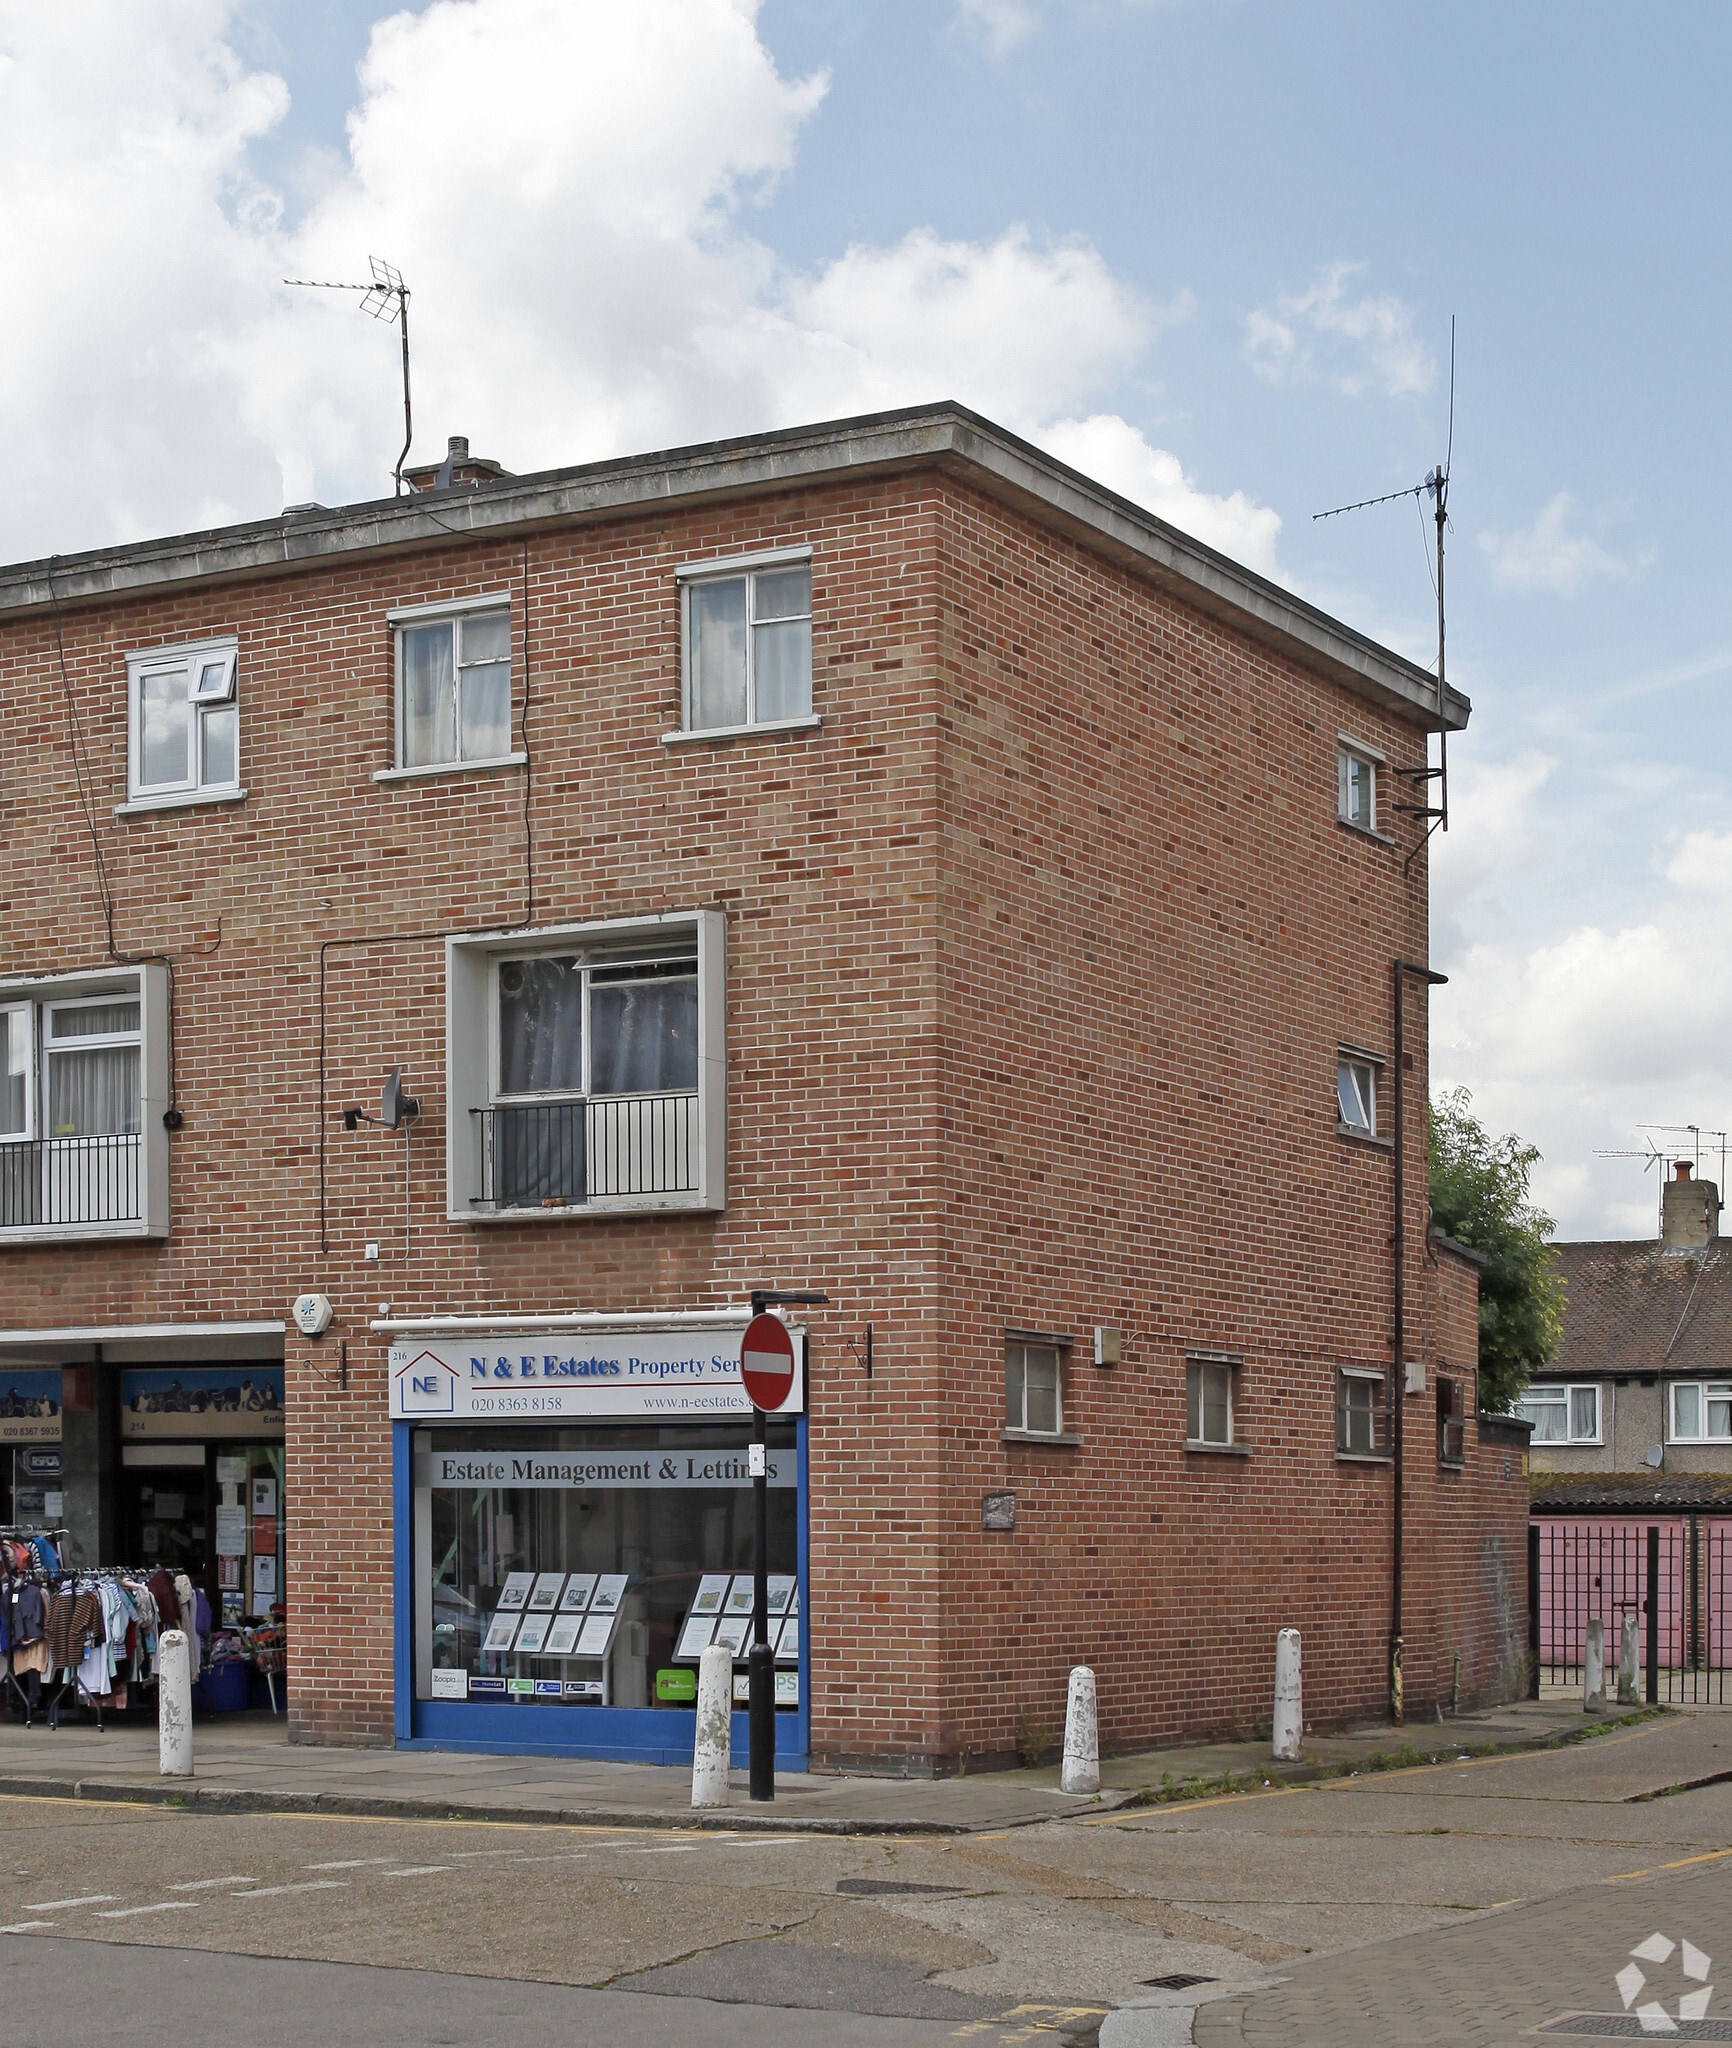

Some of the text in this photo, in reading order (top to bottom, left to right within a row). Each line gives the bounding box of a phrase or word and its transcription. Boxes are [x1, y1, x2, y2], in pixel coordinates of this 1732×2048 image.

[393, 1352, 407, 1361] 216
[469, 1355, 741, 1378] N & E Estates Property Ser
[412, 1376, 438, 1393] NE
[472, 1397, 562, 1411] 020 8363 8158
[644, 1396, 754, 1409] www.n-eestates.c
[263, 1415, 285, 1424] Enfie
[4, 1428, 18, 1436] 020
[41, 1427, 59, 1436] 5935
[131, 1423, 145, 1431] 214
[441, 1458, 778, 1485] Estate Management & Lettins
